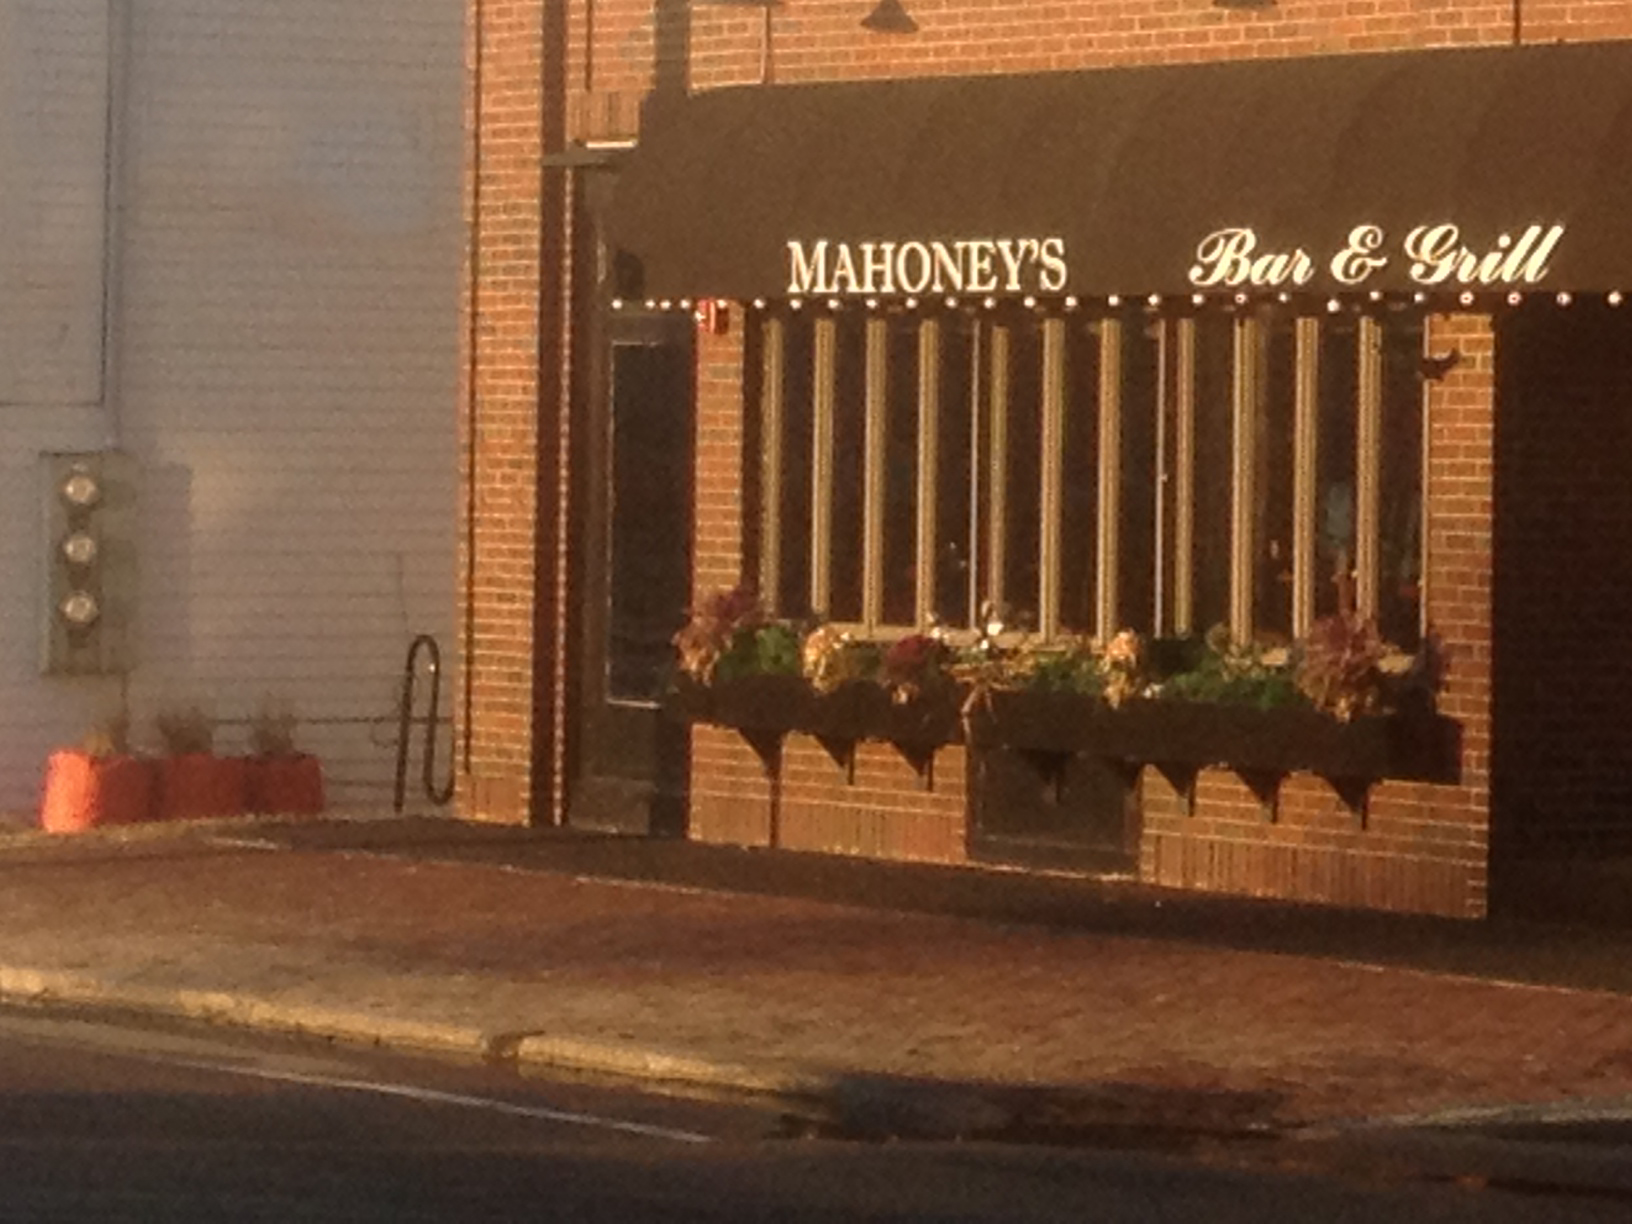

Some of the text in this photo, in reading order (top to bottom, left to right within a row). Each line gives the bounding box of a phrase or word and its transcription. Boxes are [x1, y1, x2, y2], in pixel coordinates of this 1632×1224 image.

[786, 238, 1068, 294] MAHONEY'S
[1187, 223, 1565, 287] Bar & Grill
